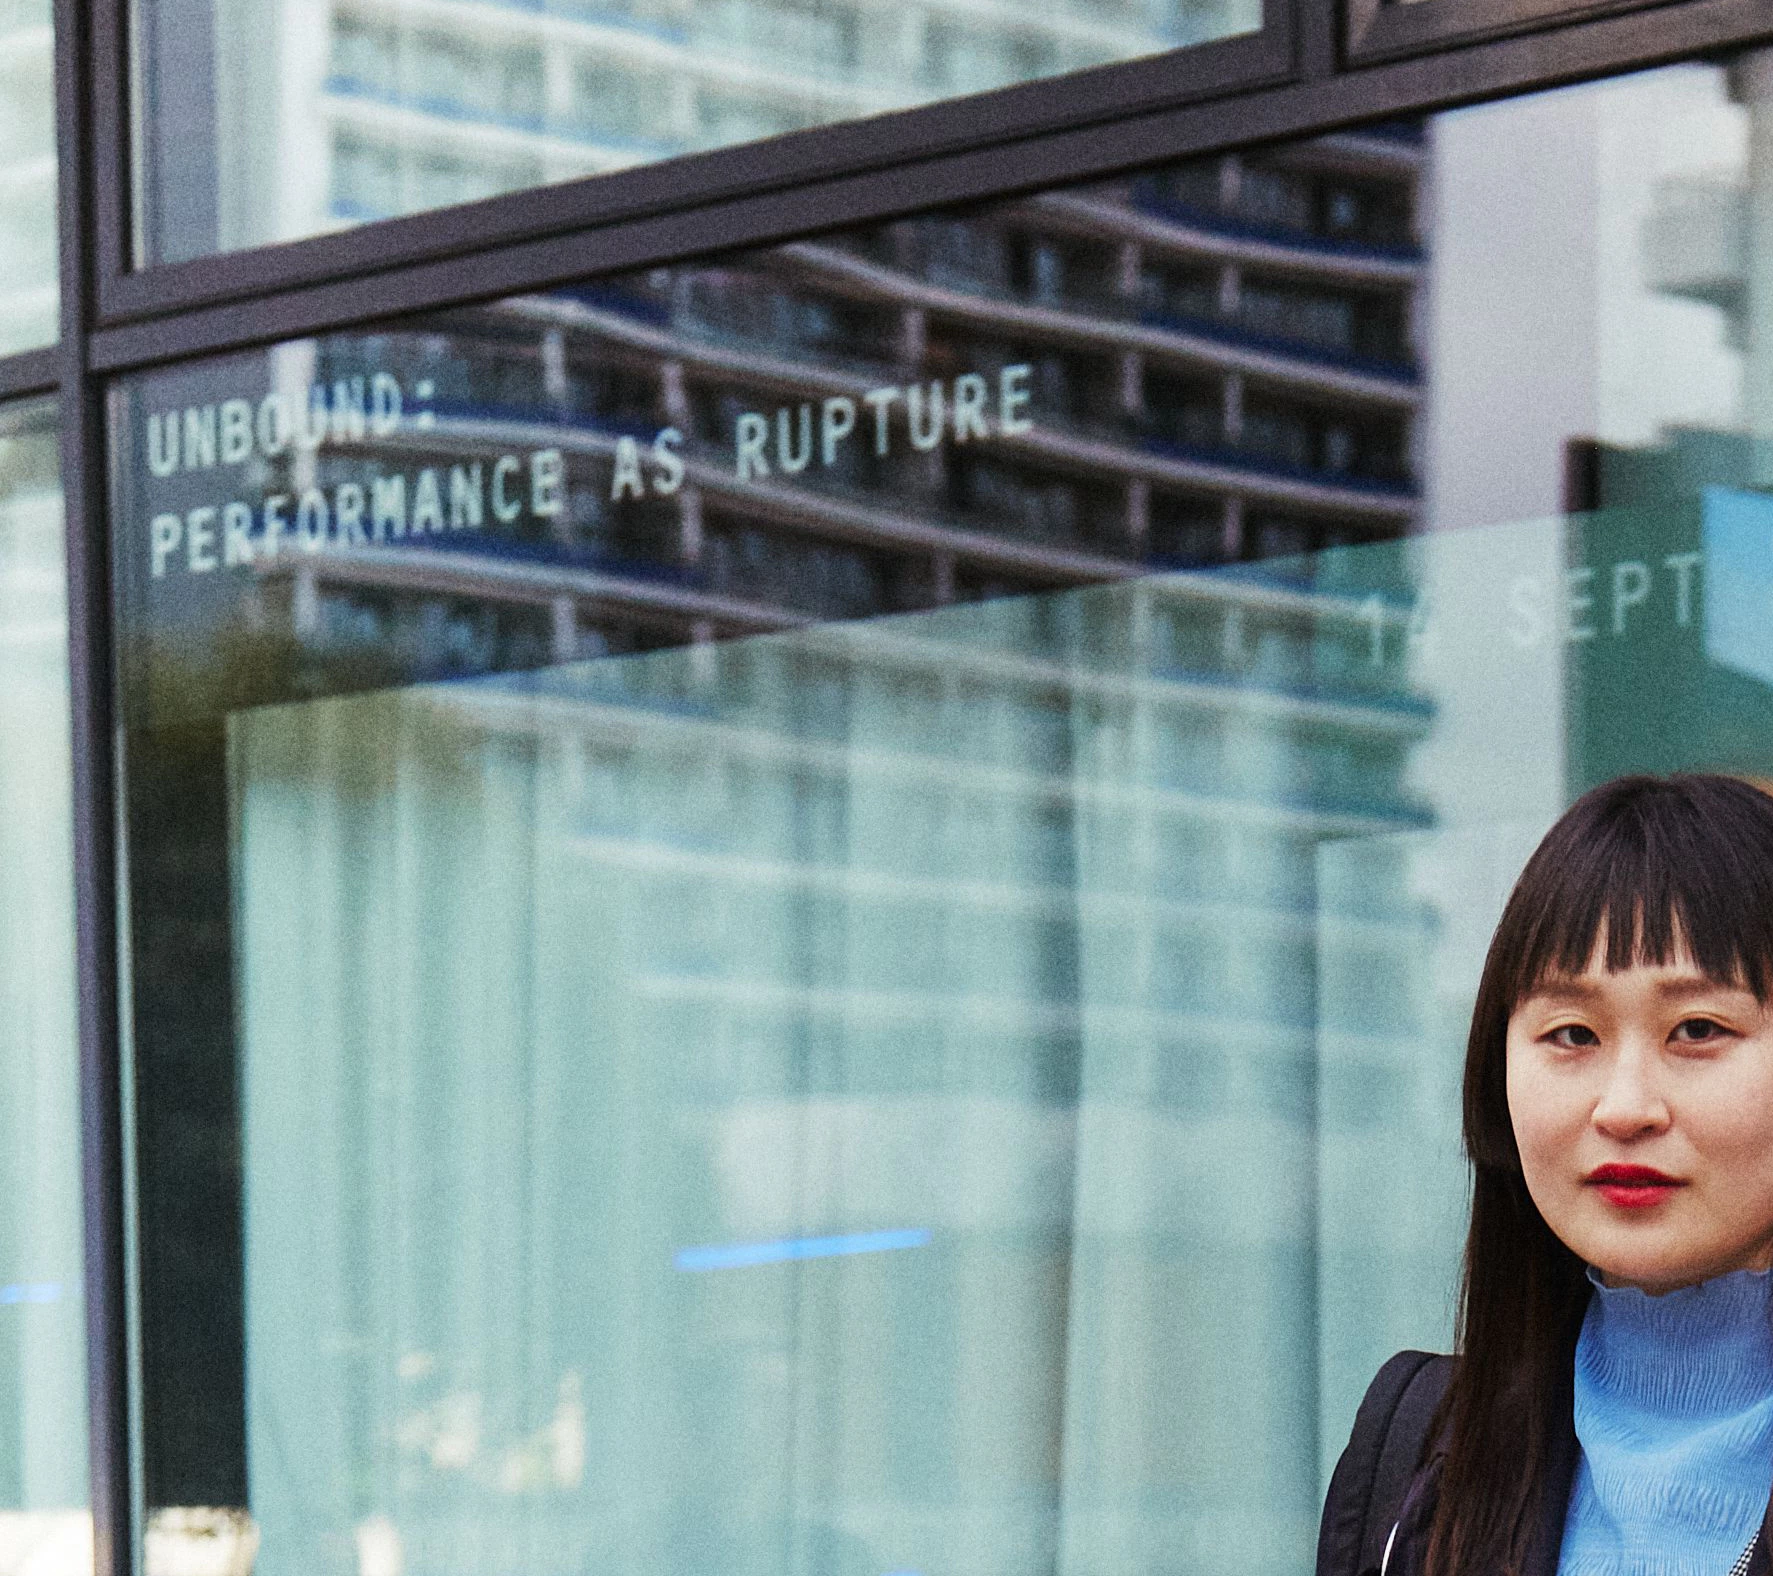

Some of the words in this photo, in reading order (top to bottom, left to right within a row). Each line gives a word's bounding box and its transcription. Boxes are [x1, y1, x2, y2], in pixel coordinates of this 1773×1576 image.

[147, 371, 436, 477] UNBOUND:
[150, 447, 564, 577] PERFORMANCE
[610, 428, 685, 501] AS
[737, 363, 1034, 483] RUPTURE
[1508, 552, 1702, 648] SEPT
